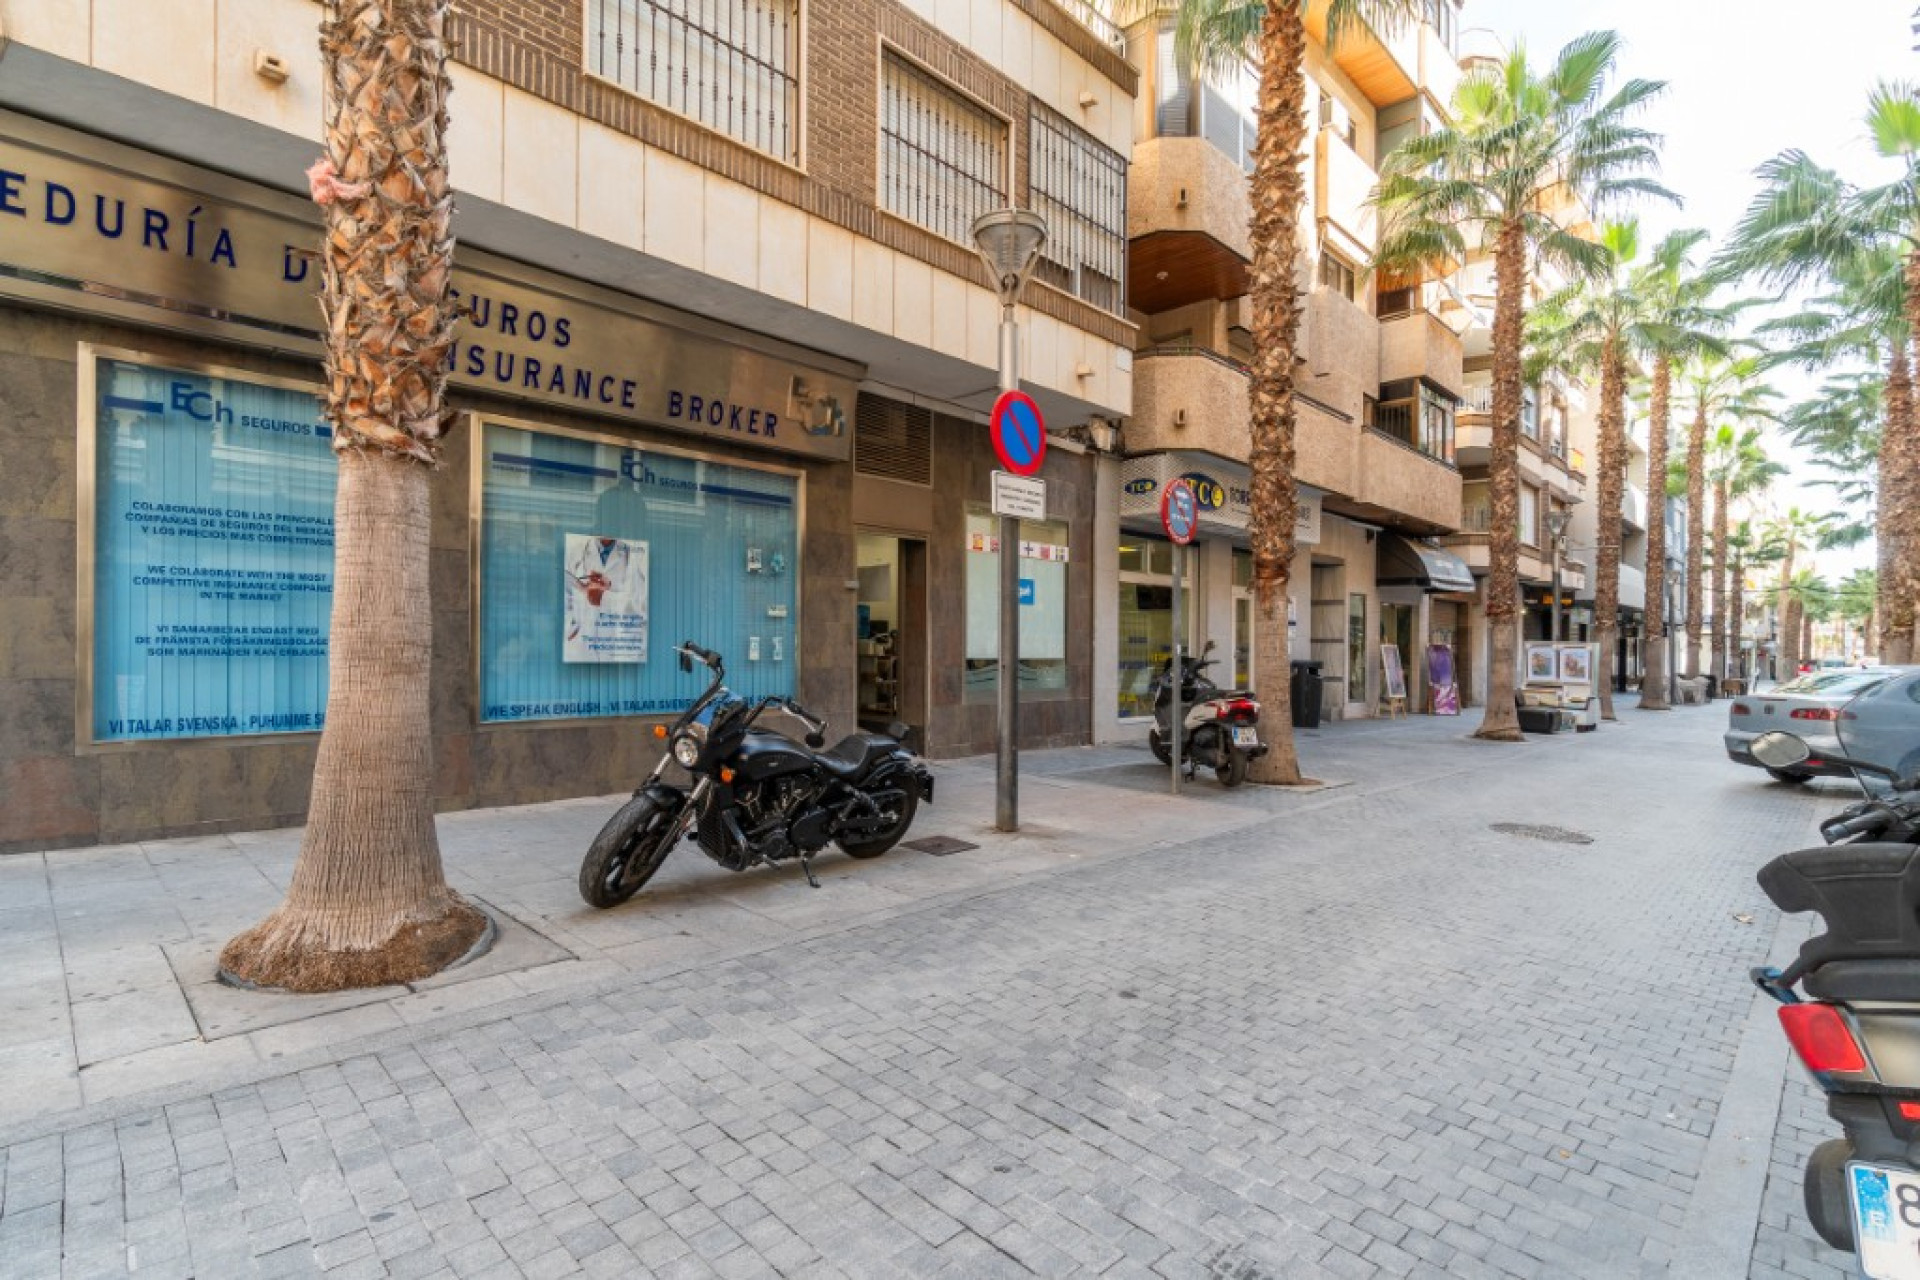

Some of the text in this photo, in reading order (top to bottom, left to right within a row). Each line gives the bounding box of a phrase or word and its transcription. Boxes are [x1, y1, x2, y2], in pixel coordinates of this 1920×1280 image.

[667, 389, 778, 438] BROKER
[241, 415, 311, 435] SEGUROS
[252, 511, 273, 520] LAS
[141, 525, 149, 534] Y
[153, 526, 175, 535] LOS
[200, 519, 216, 528] DE
[219, 519, 271, 531] SEGUROS
[147, 565, 166, 575] WE
[169, 566, 246, 578] COLABORATE
[247, 571, 273, 580] WITH
[133, 576, 211, 587] COMPETITIVE
[510, 703, 550, 716] SPEAK
[552, 701, 600, 715] ENGLISH
[108, 719, 123, 734] VI
[127, 719, 172, 733] TALAR
[177, 716, 238, 732] SVENSKA
